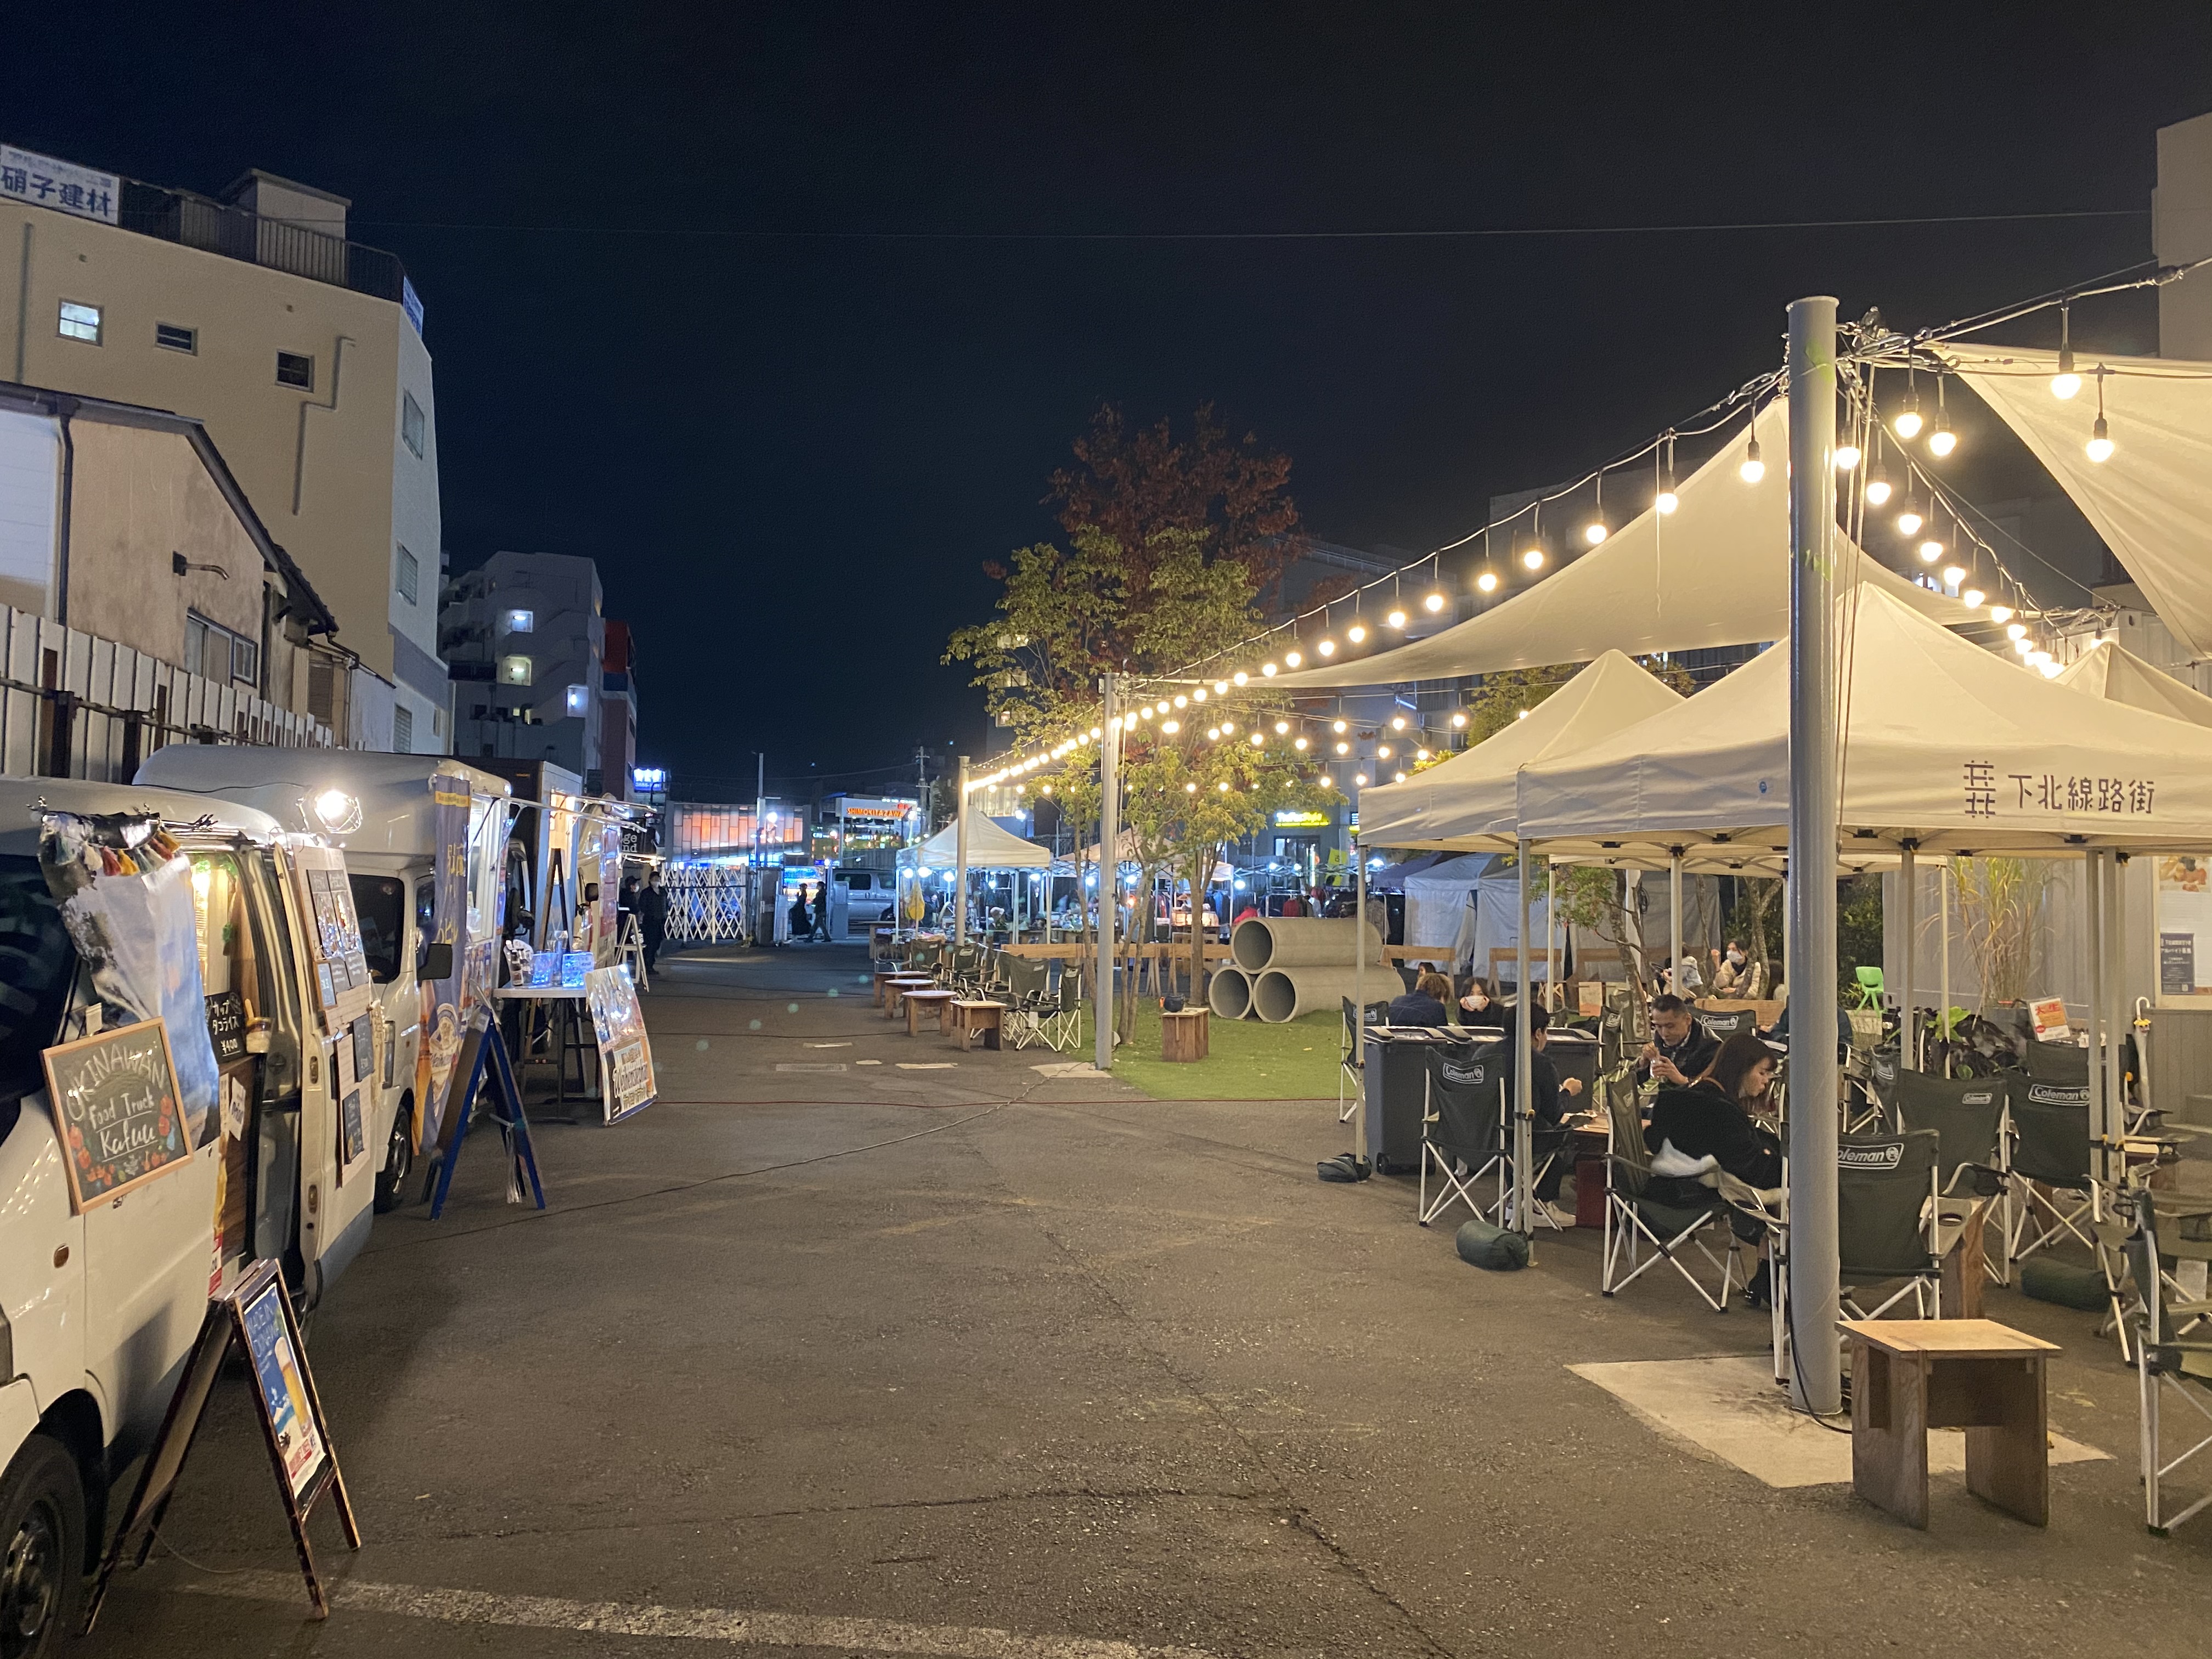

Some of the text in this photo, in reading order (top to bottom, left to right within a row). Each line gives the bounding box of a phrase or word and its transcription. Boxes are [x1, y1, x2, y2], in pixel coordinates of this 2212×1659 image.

[1, 165, 111, 217] 硝子建材
[2007, 774, 2155, 814] 下北線路街
[847, 807, 904, 818] SHIMOKITAZAWA
[622, 833, 637, 844] ge
[1703, 1017, 1730, 1026] Coleman
[221, 1038, 238, 1054] ¥400
[1445, 1065, 1474, 1080] Coleman
[66, 1043, 165, 1121] OKINAWAN
[2034, 1086, 2079, 1101] Coleman
[89, 1086, 155, 1130] Food Truck
[100, 1120, 156, 1158] Kafuu
[1838, 1148, 1885, 1162] oleman
